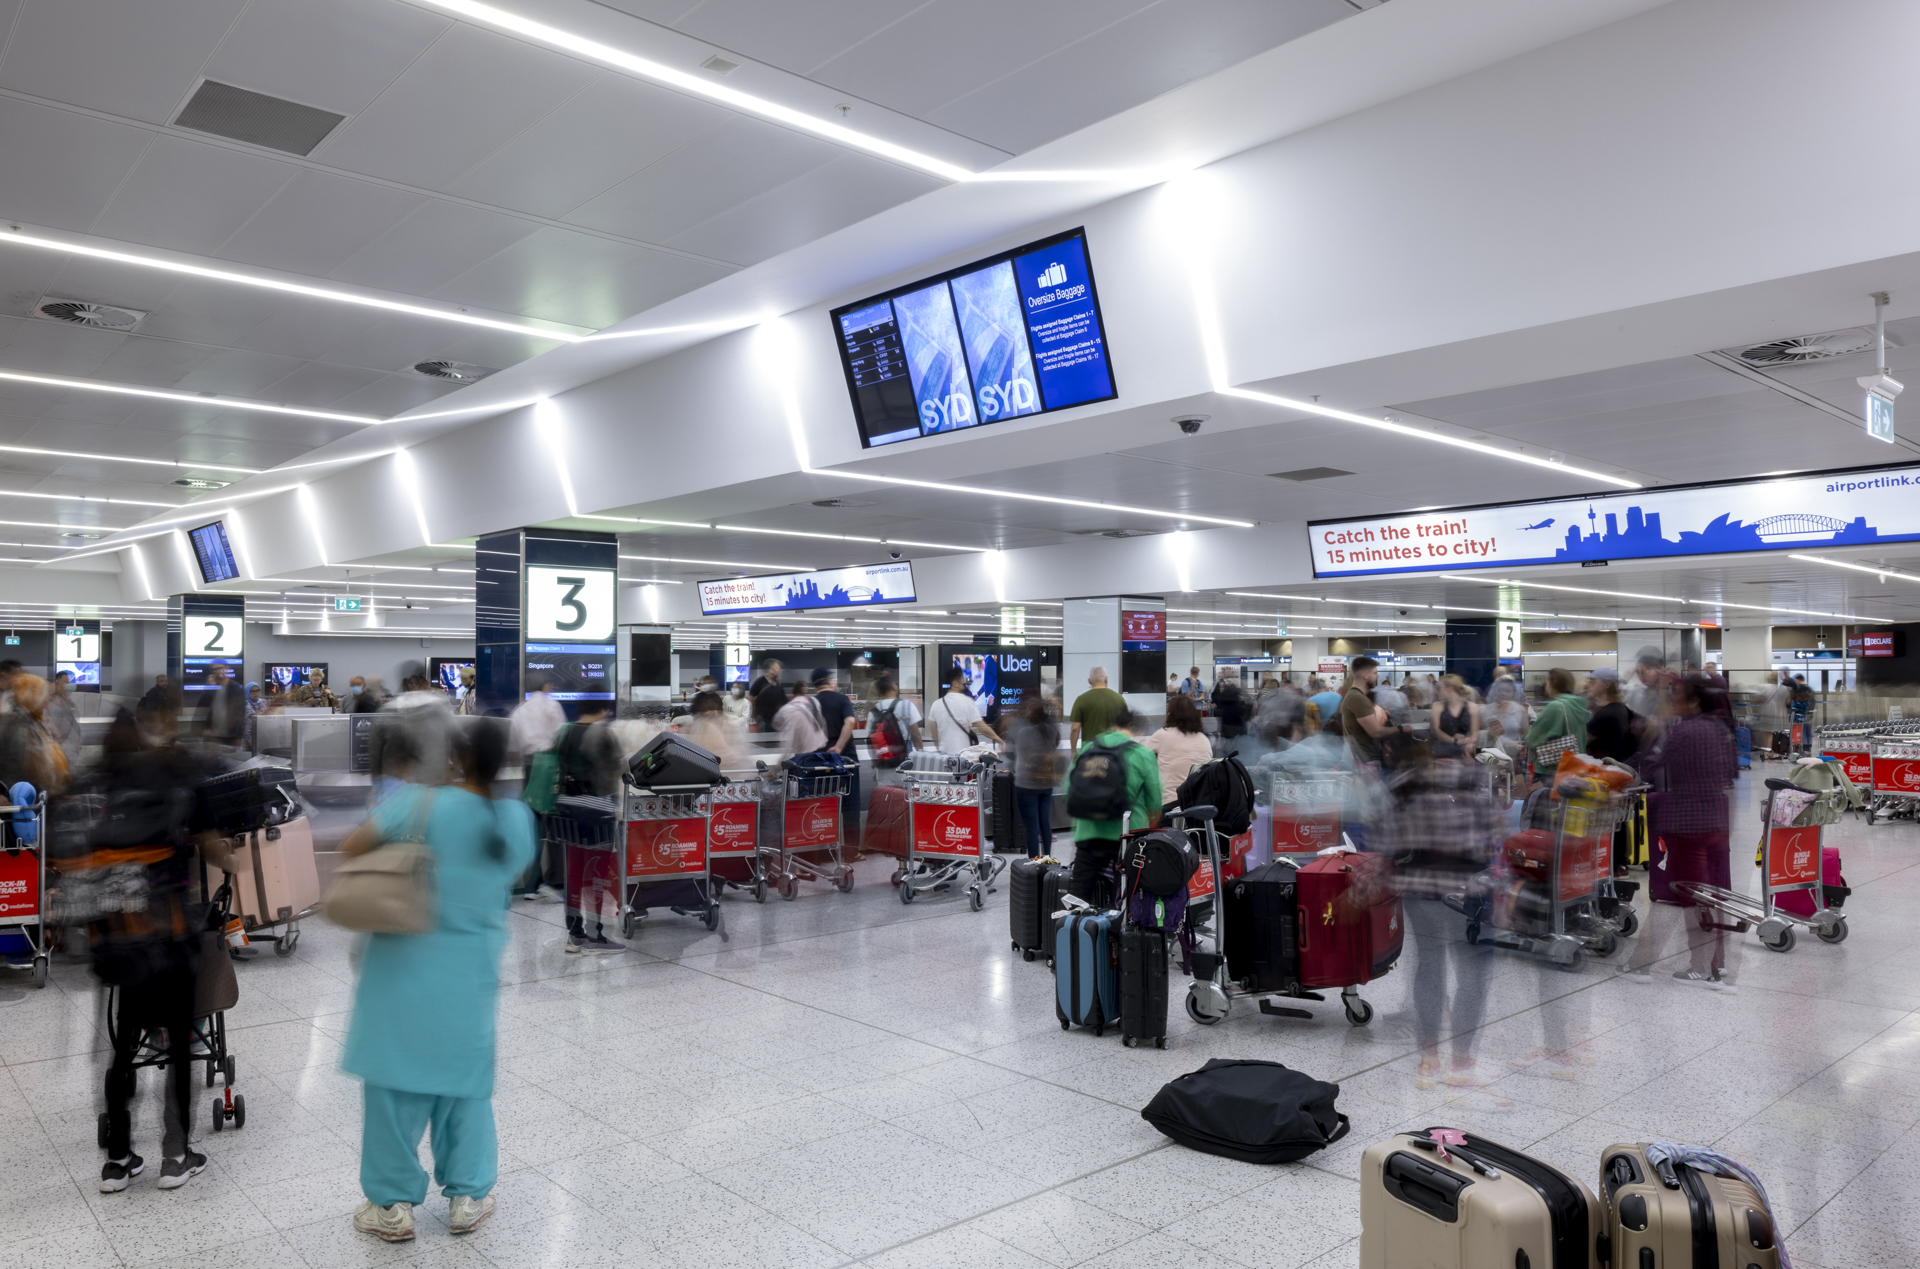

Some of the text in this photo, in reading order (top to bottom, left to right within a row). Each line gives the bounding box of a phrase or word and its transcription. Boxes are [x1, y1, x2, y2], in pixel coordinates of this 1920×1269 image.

[1028, 284, 1085, 308] Oversize Baggage
[1058, 317, 1073, 325] Baggage
[1073, 313, 1086, 321] Claims
[1060, 331, 1075, 339] Baggage
[1063, 344, 1078, 353] Baggage
[979, 378, 1035, 416] SYD
[920, 392, 971, 429] SYD
[1324, 519, 1468, 546] Catch the train!
[1327, 537, 1497, 564] 15 minutes to city!
[866, 566, 909, 576] airportlink.com.au
[704, 582, 756, 595] Catch the train!
[556, 576, 587, 632] 3
[706, 593, 766, 606] 15 minutes to city!
[204, 621, 224, 652] 2
[1506, 626, 1514, 653] 3
[71, 637, 82, 658] 1
[734, 648, 740, 663] 1
[528, 662, 554, 670] Singapore
[1000, 654, 1033, 672] Uber
[1001, 687, 1013, 695] See
[1001, 696, 1024, 705] outsid
[714, 824, 725, 836] $5
[946, 826, 971, 835] 35 DAY
[1300, 825, 1310, 836] $5
[659, 843, 671, 856] $5
[1794, 851, 1811, 859] BUNDLE
